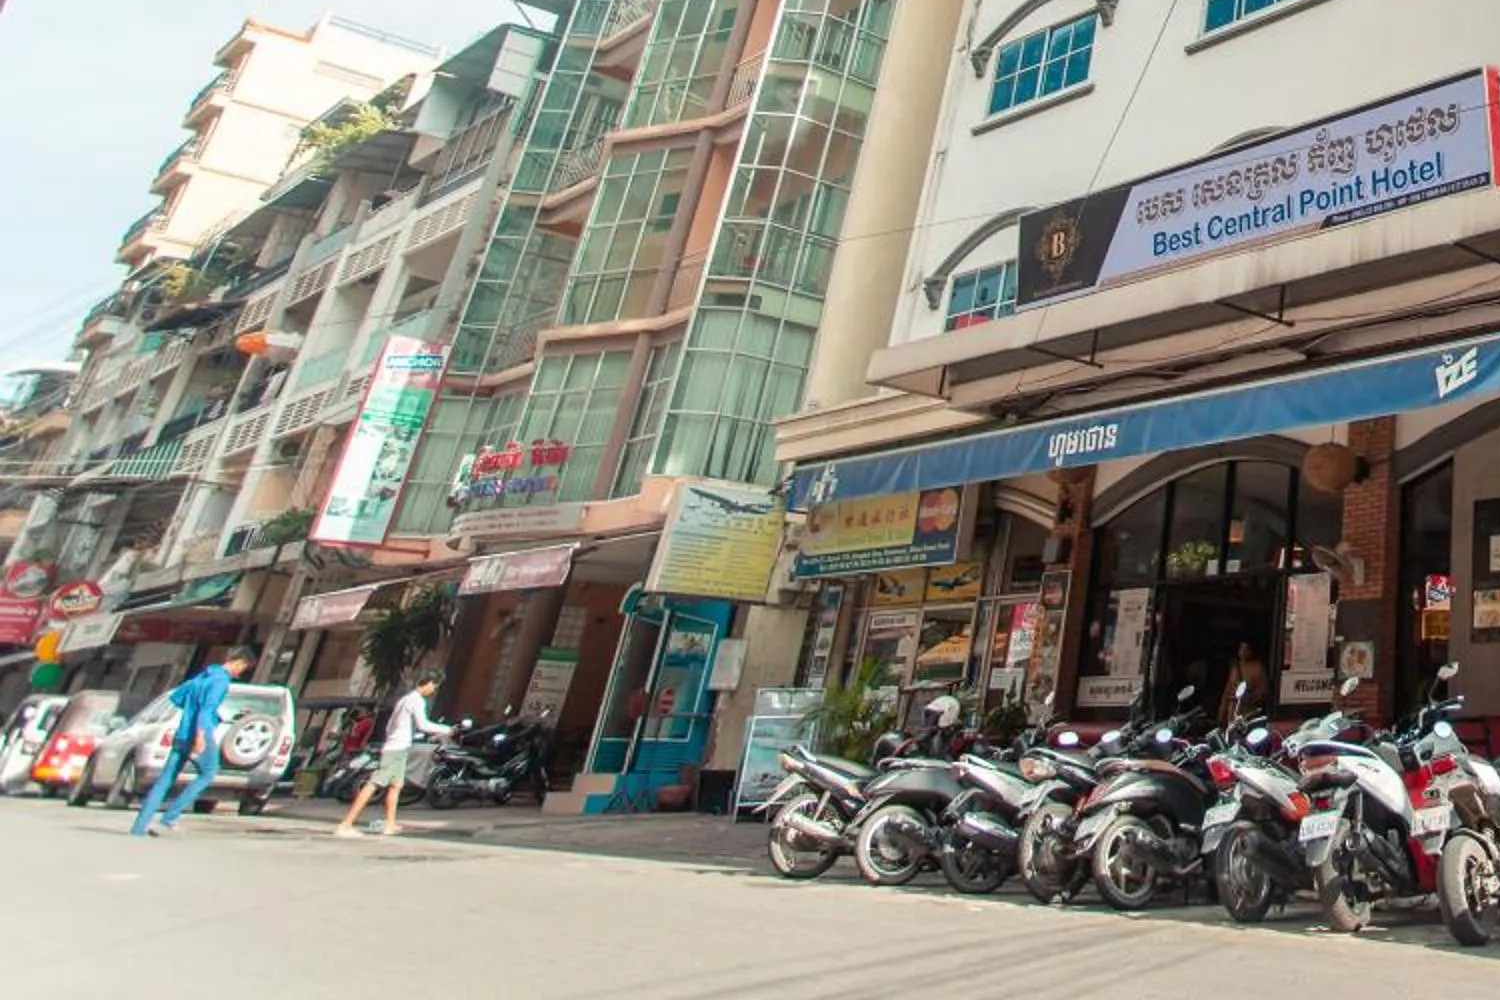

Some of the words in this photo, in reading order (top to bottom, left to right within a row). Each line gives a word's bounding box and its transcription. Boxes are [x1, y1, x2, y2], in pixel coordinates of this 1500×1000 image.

[1152, 218, 1201, 257] Best
[1207, 201, 1292, 240] Central
[1300, 174, 1362, 215] Point
[1371, 151, 1443, 197] Hotel
